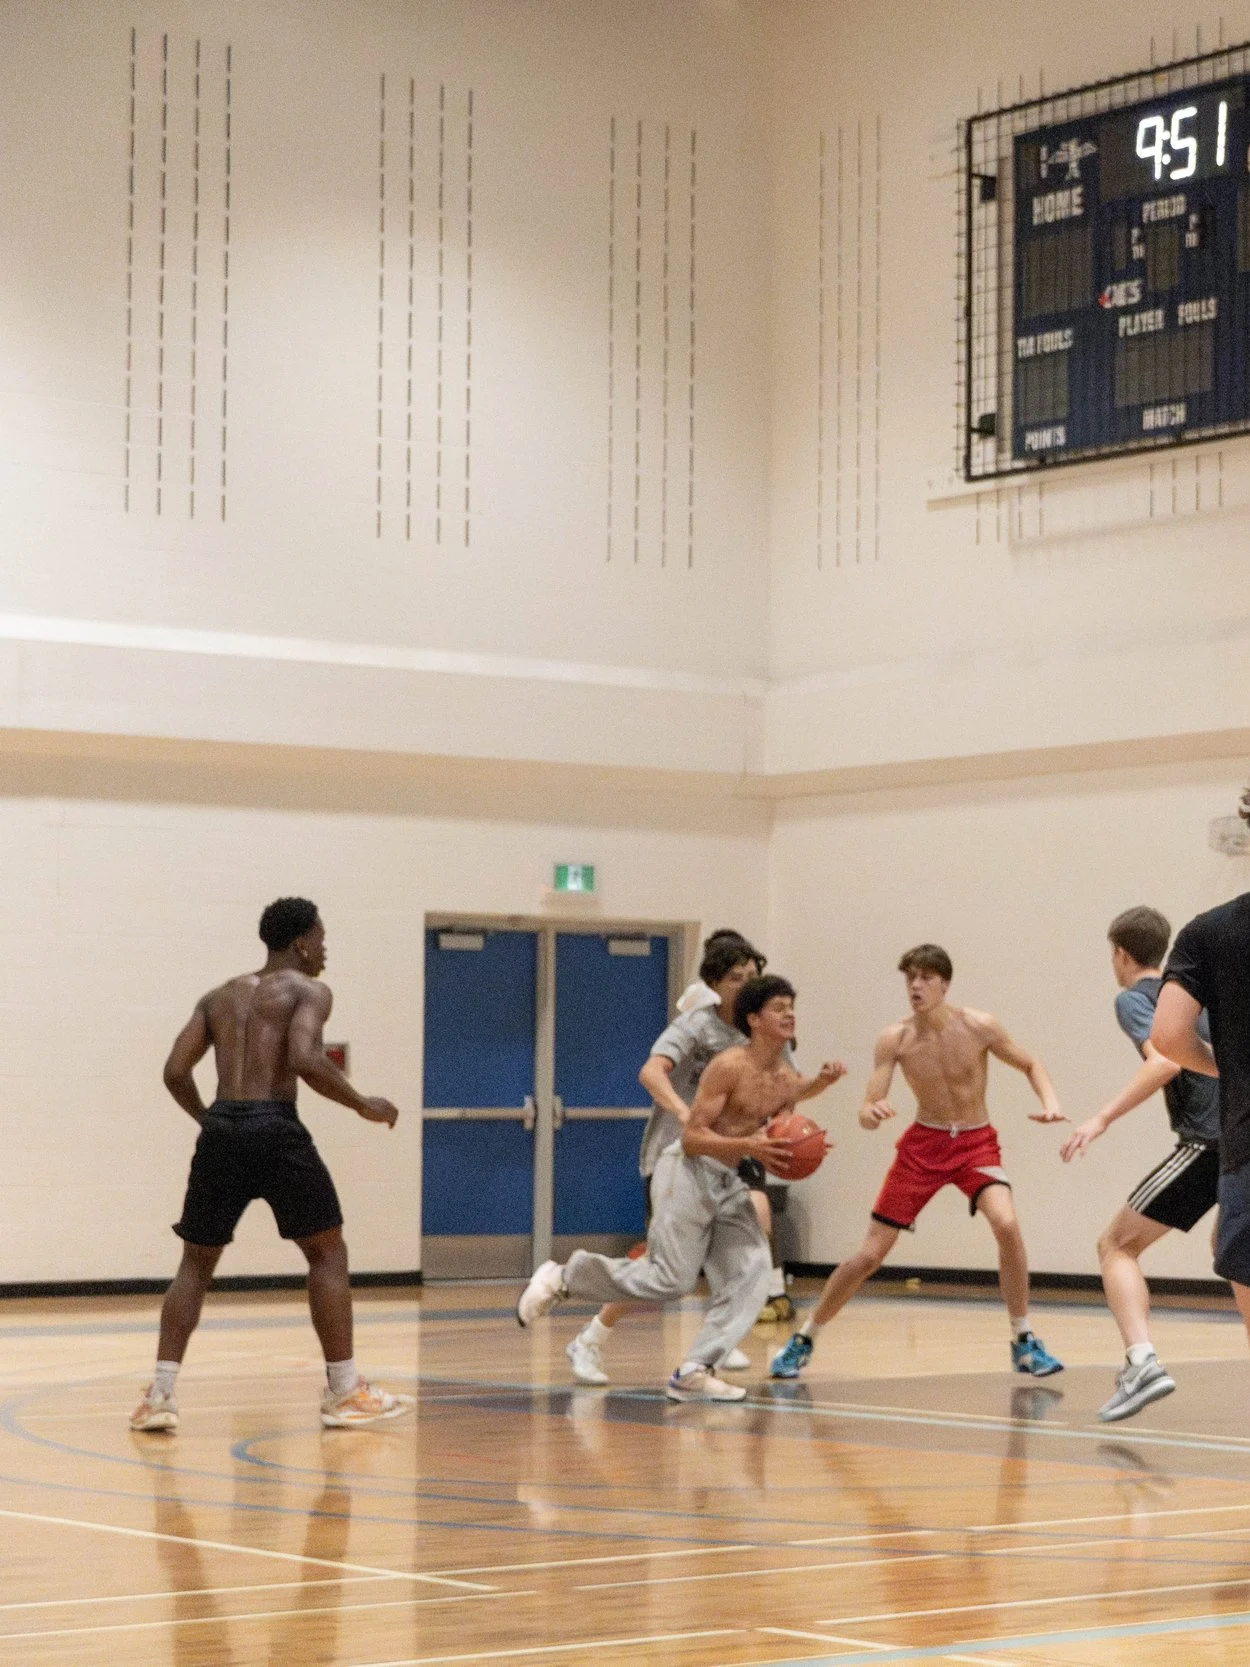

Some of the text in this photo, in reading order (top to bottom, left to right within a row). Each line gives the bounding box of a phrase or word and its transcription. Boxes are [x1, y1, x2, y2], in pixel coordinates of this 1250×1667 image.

[1136, 101, 1228, 181] 9:51
[1033, 185, 1085, 226] HOME
[1118, 296, 1217, 338] PLAYER FOULS
[1036, 328, 1074, 355] FOULS
[1025, 425, 1067, 451] POINTS
